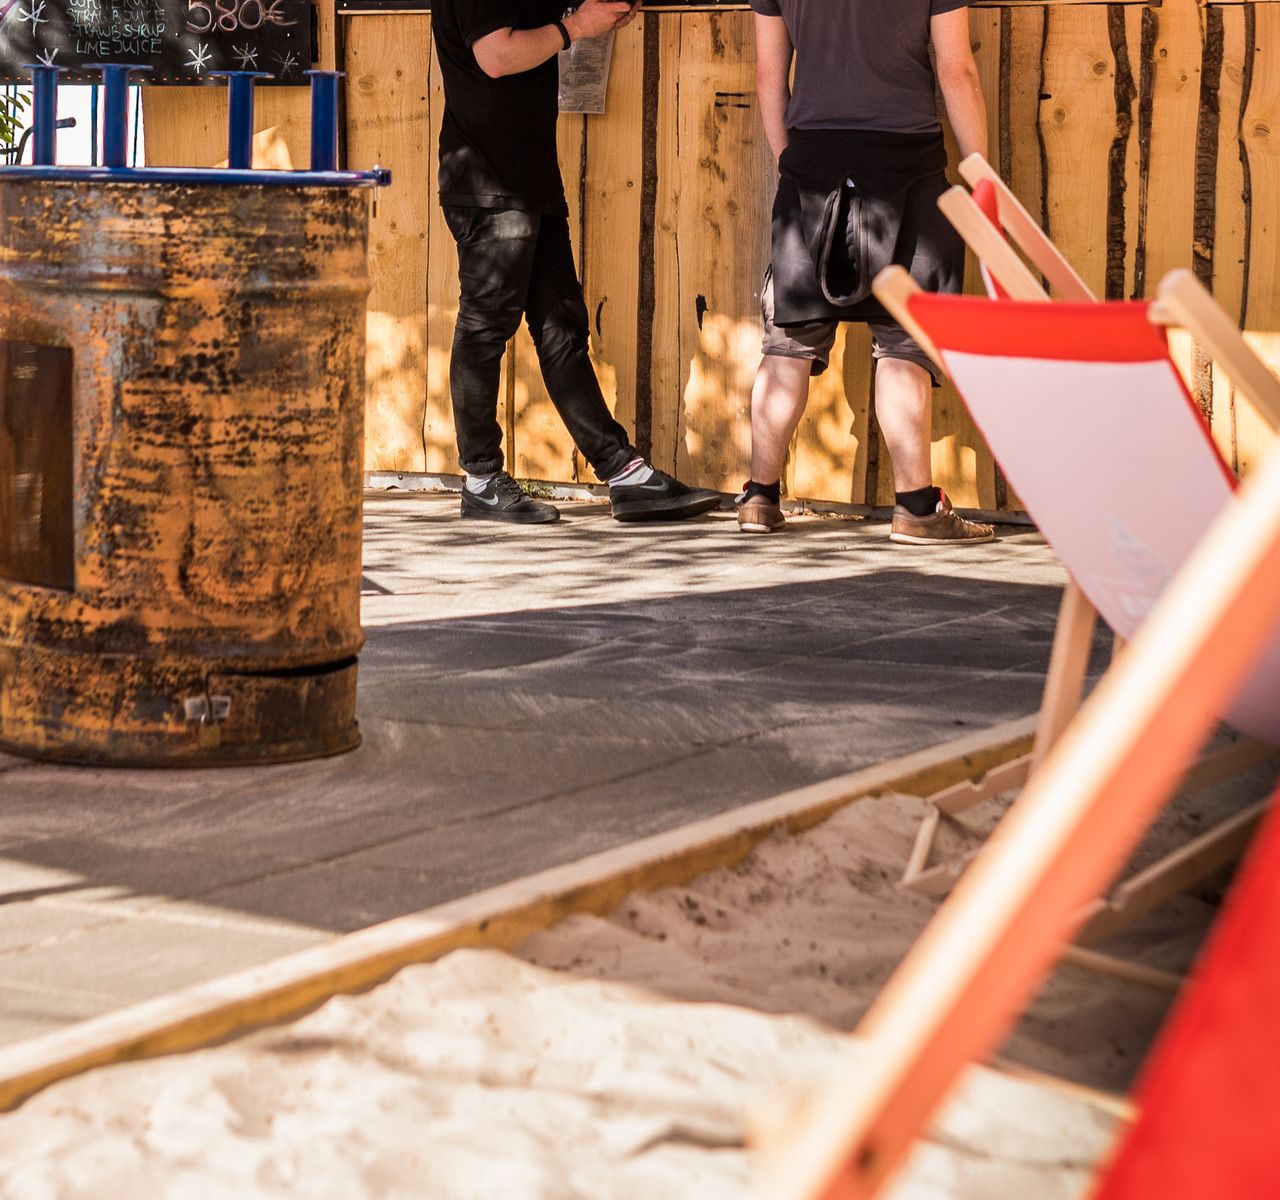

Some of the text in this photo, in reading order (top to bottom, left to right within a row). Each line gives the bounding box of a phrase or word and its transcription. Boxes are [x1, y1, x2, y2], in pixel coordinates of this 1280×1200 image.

[122, 23, 165, 40] SYRUP
[76, 38, 163, 57] LIME JUICE
